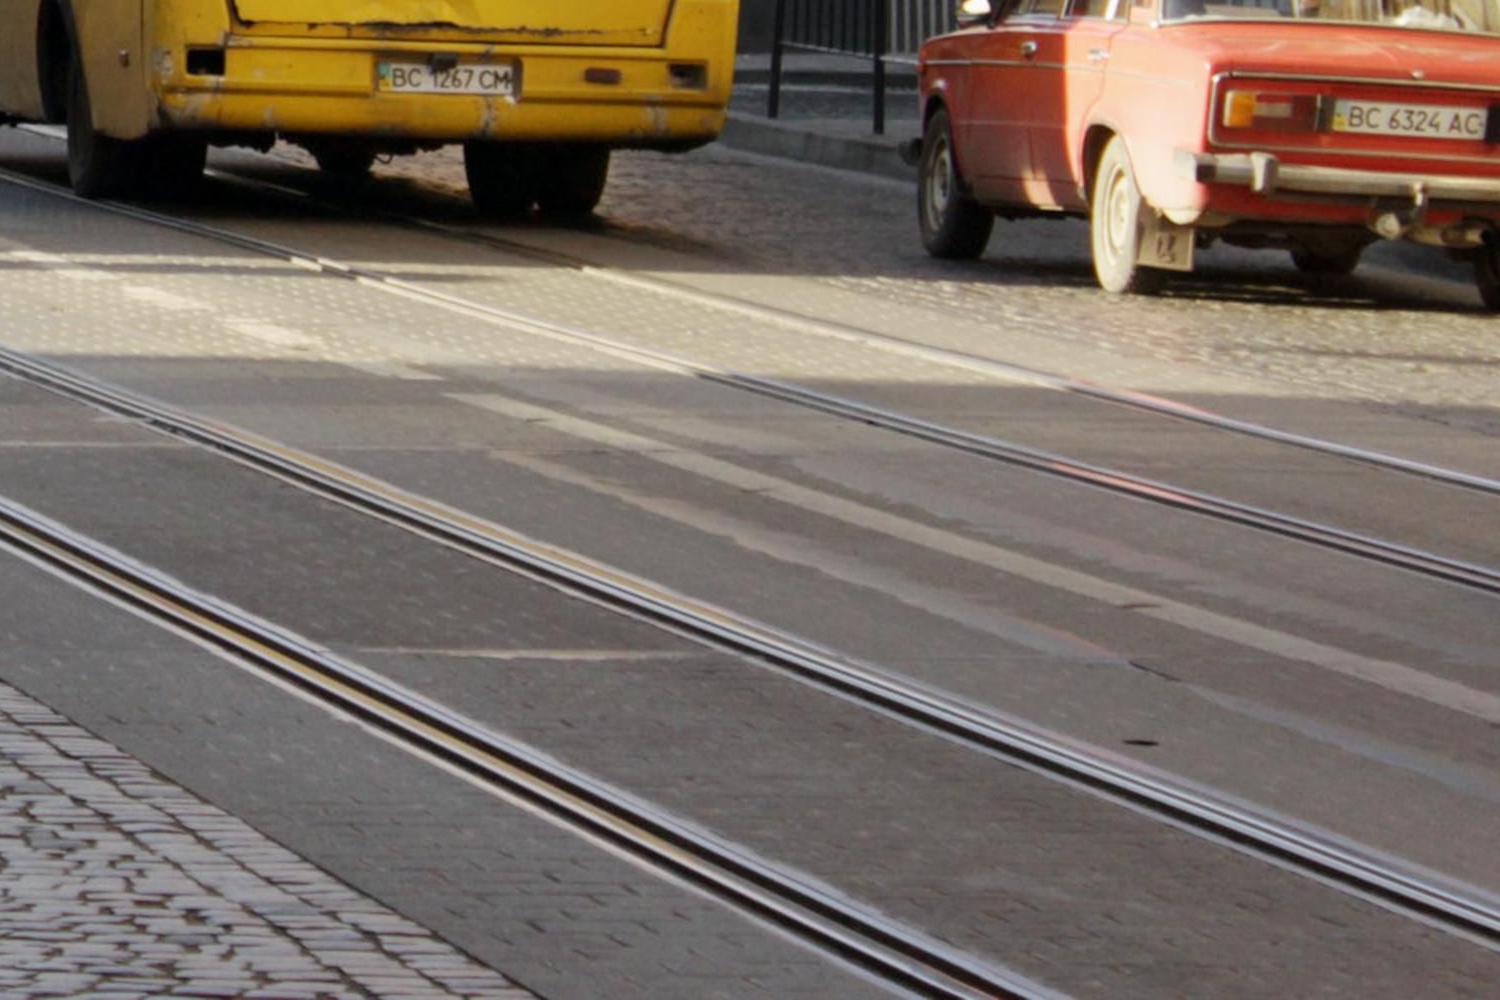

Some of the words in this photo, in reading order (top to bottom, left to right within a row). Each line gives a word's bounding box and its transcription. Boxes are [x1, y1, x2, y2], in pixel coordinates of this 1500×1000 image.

[391, 68, 422, 89] BC
[432, 68, 475, 89] 1267
[1349, 105, 1381, 129] BC
[1388, 109, 1442, 134] 6324
[1448, 112, 1482, 136] AC
